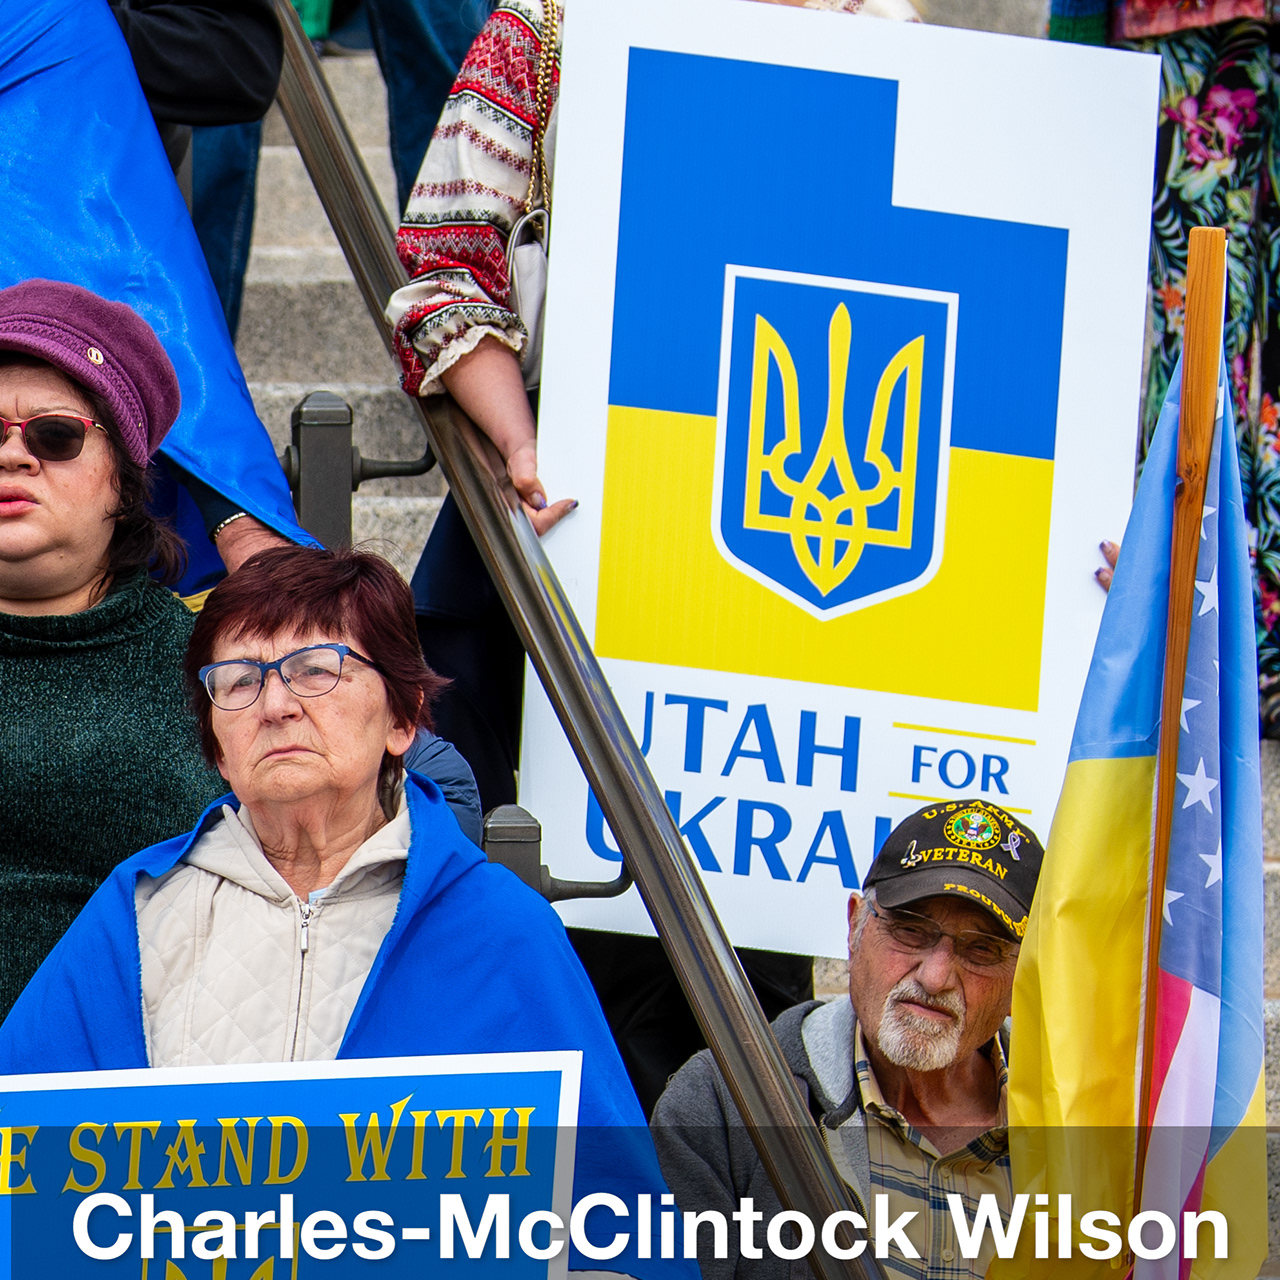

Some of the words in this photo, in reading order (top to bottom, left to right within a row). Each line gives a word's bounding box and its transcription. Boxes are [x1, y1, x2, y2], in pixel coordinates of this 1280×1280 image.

[912, 744, 1011, 796] FOR
[920, 847, 1009, 880] VETERAN
[61, 1115, 310, 1194] STAND
[340, 1091, 537, 1183] WITH
